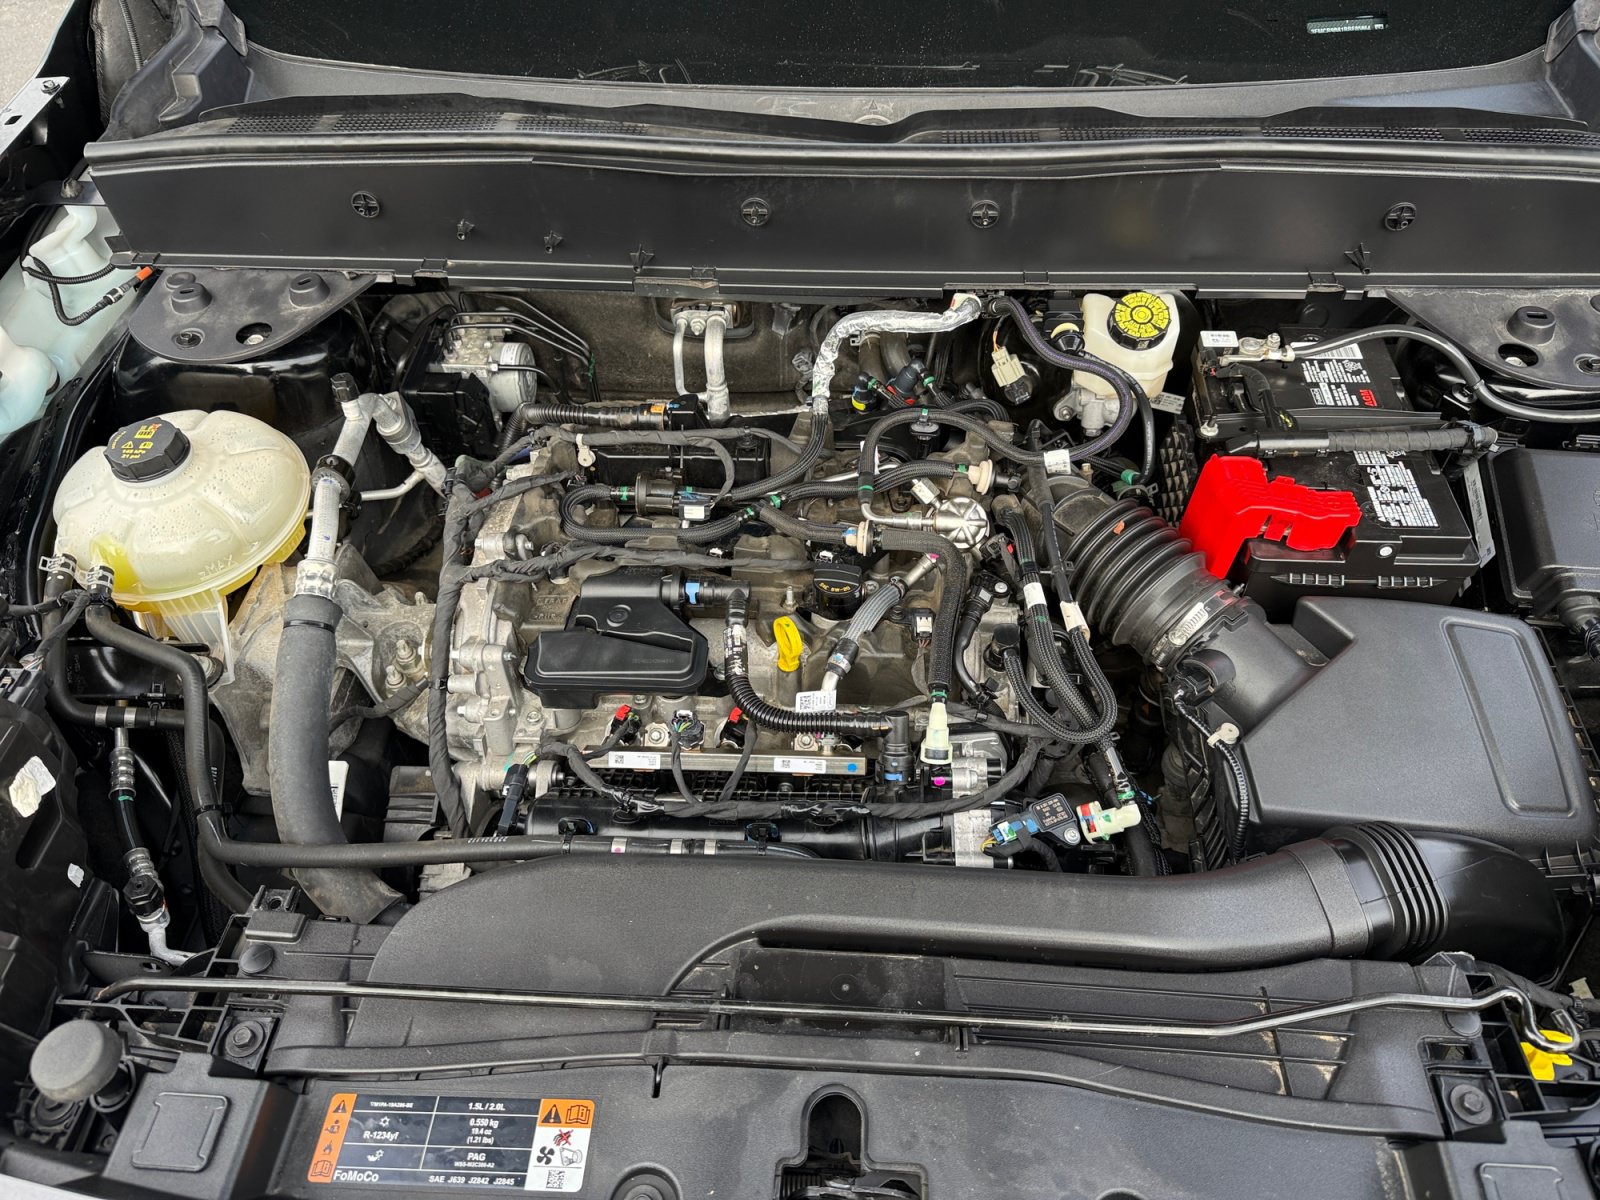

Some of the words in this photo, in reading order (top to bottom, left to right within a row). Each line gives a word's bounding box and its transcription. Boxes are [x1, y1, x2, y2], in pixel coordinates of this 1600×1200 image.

[204, 554, 239, 575] MAX
[468, 1102, 484, 1111] 1.5L
[489, 1103, 505, 1111] 2.0L
[469, 1118, 489, 1127] 0.550
[489, 1118, 499, 1128] kg
[363, 1131, 399, 1141] R-1234yf
[467, 1152, 486, 1161] PAG
[333, 1171, 379, 1182] FoMoCo
[429, 1175, 445, 1183] SAE
[447, 1176, 466, 1184] J639
[468, 1176, 489, 1185] J2842
[493, 1177, 515, 1186] J2845
